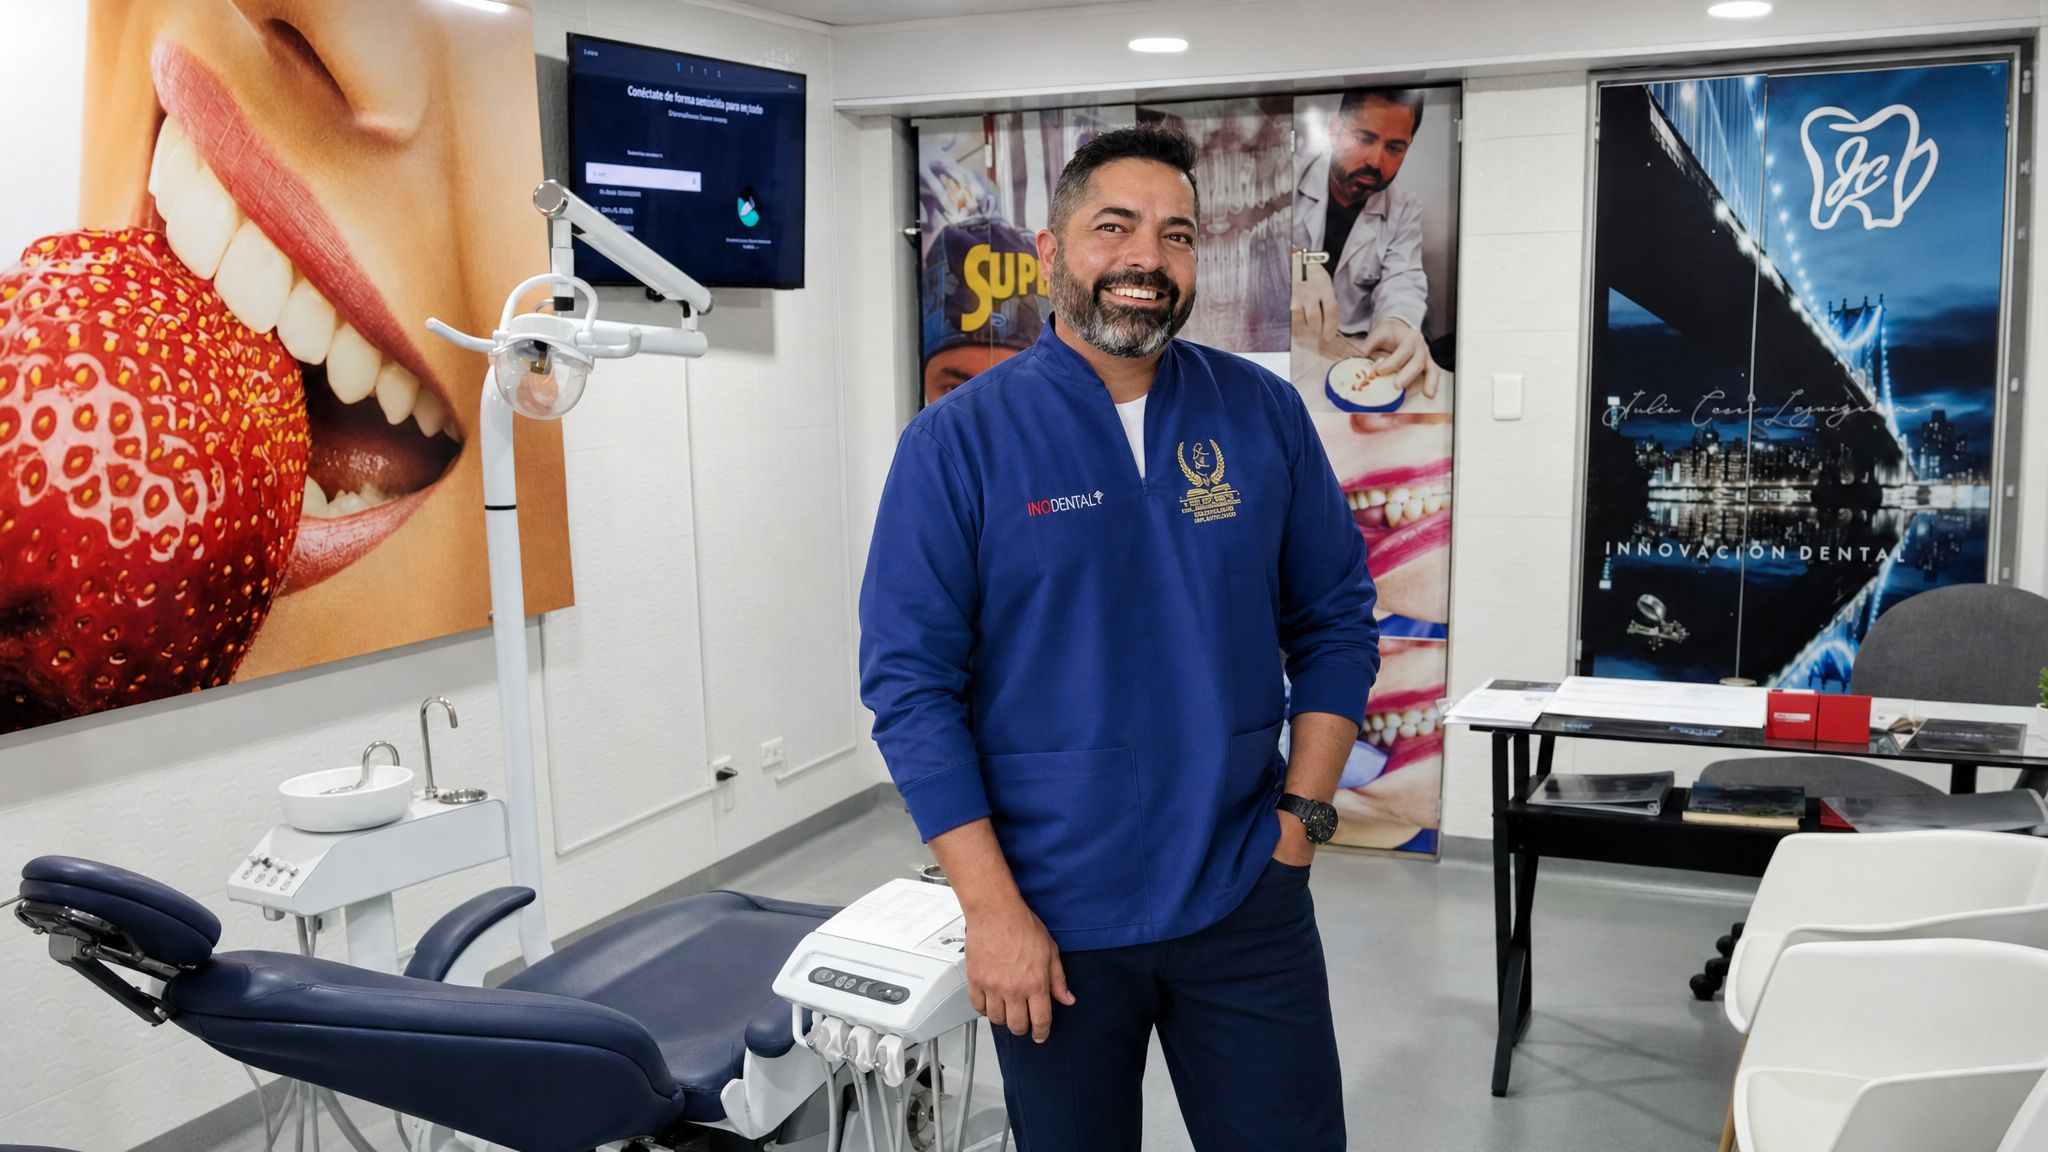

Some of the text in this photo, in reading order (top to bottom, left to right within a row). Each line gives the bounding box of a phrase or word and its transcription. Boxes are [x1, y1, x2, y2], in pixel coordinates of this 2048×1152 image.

[627, 85, 663, 101] Conéctate
[664, 91, 673, 102] de
[675, 92, 695, 106] forma
[726, 101, 740, 112] para
[1601, 390, 1681, 427] Julio
[1605, 540, 1906, 563] INNOVACIÓN DENTAL
